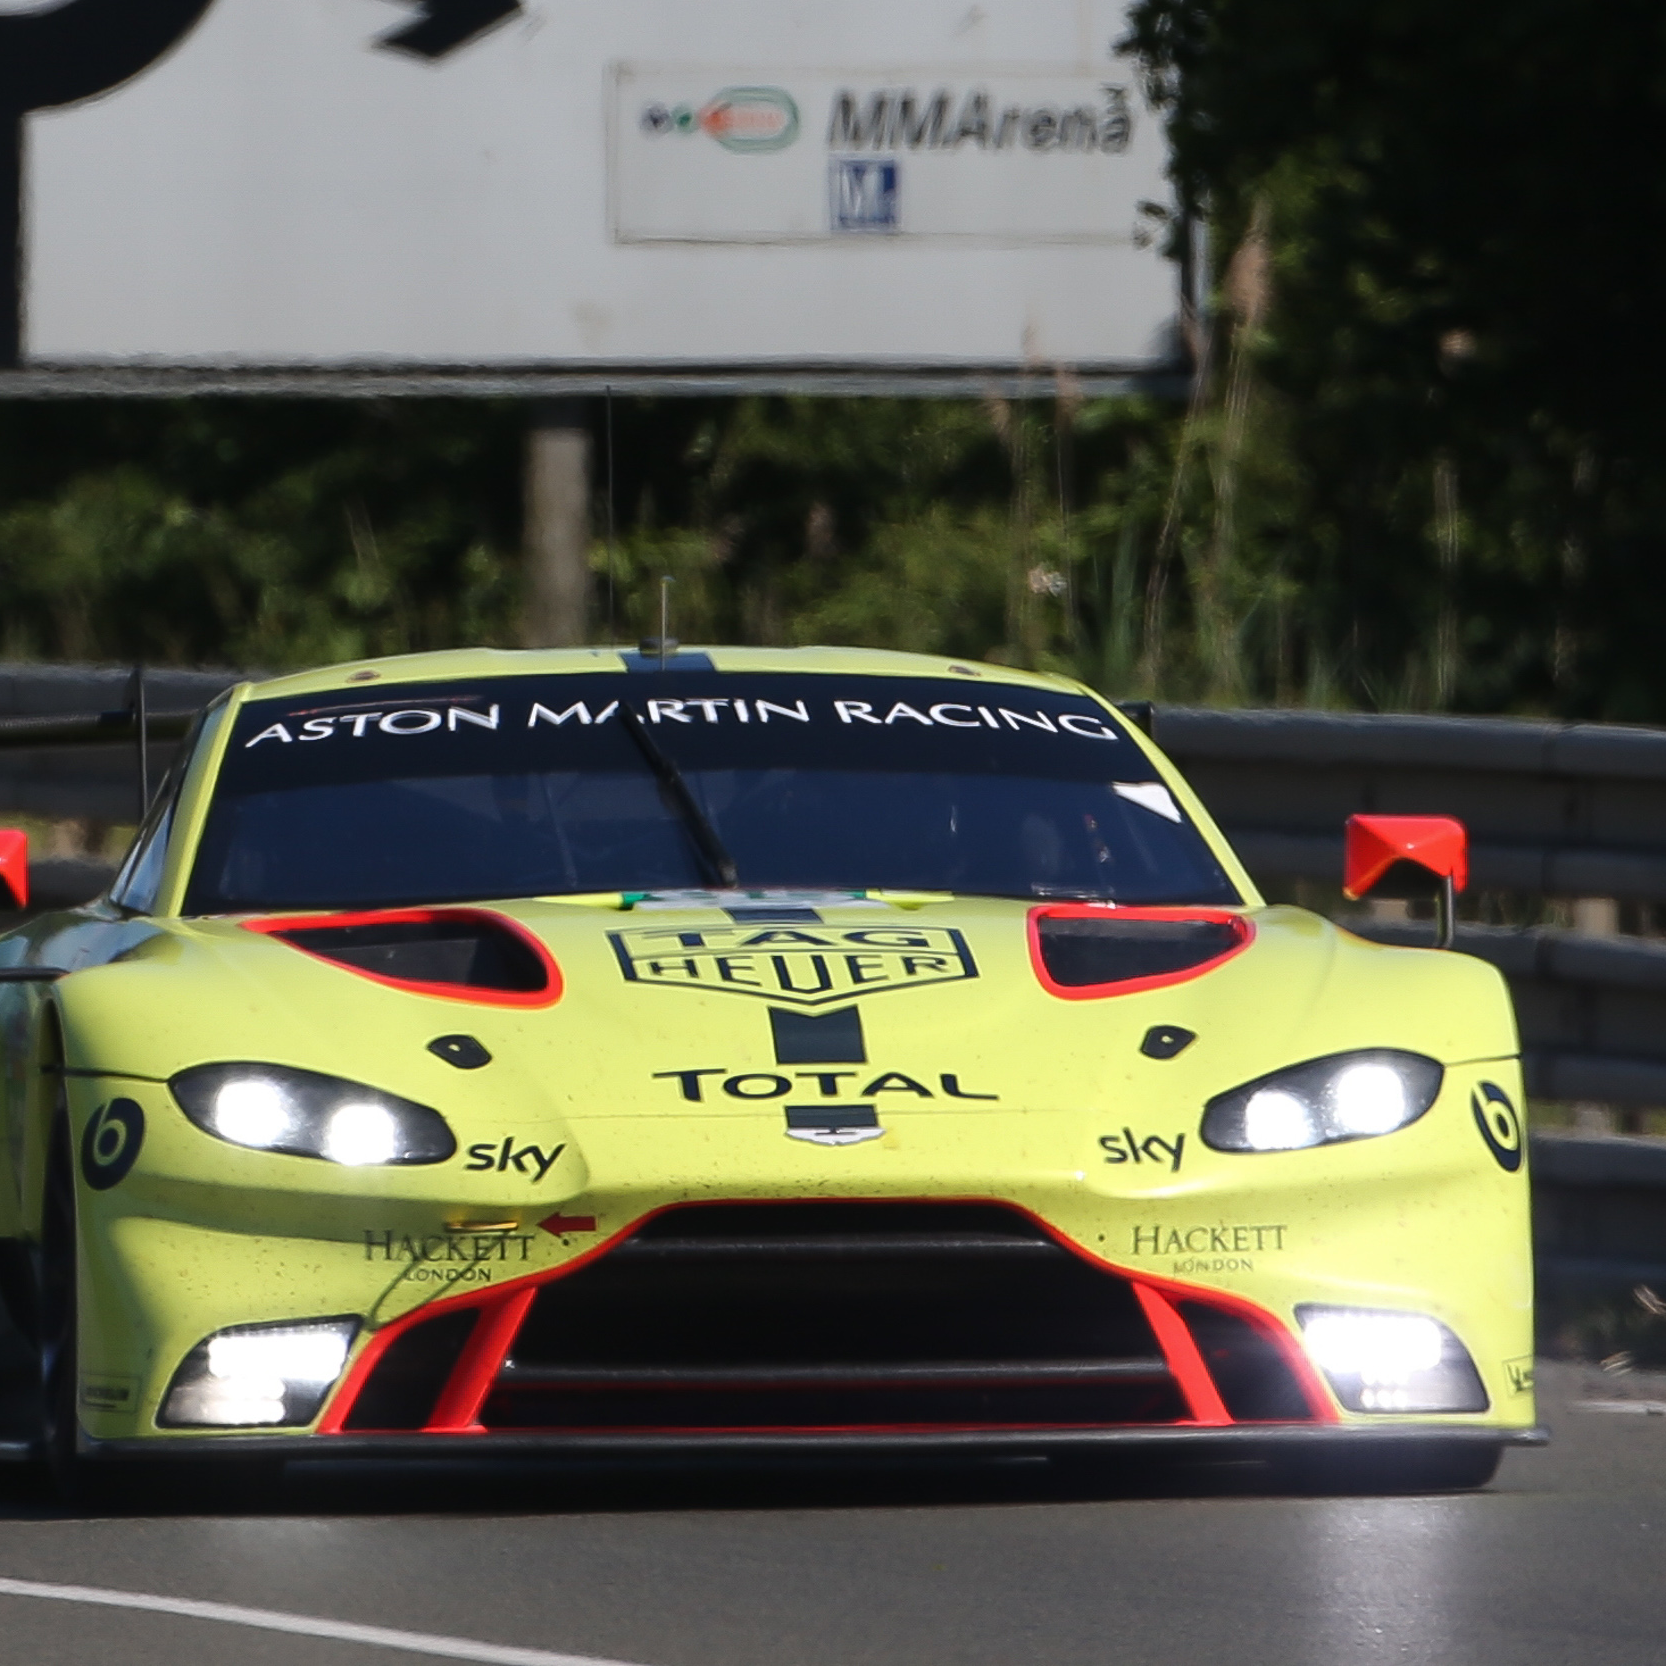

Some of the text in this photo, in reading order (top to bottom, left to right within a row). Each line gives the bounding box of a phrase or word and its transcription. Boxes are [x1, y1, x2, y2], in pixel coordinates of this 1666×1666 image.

[244, 704, 501, 748] ASTON
[834, 700, 1119, 741] RACING
[640, 928, 933, 948] TAG
[650, 954, 950, 995] HEUER
[652, 1068, 1001, 1103] TOTAL
[465, 1136, 566, 1184] sky
[1099, 1127, 1186, 1172] sky
[364, 1230, 536, 1263] HACKETT
[1132, 1224, 1288, 1255] HACKETT
[405, 1268, 492, 1283] LONDON
[1172, 1256, 1254, 1274] LONDON
